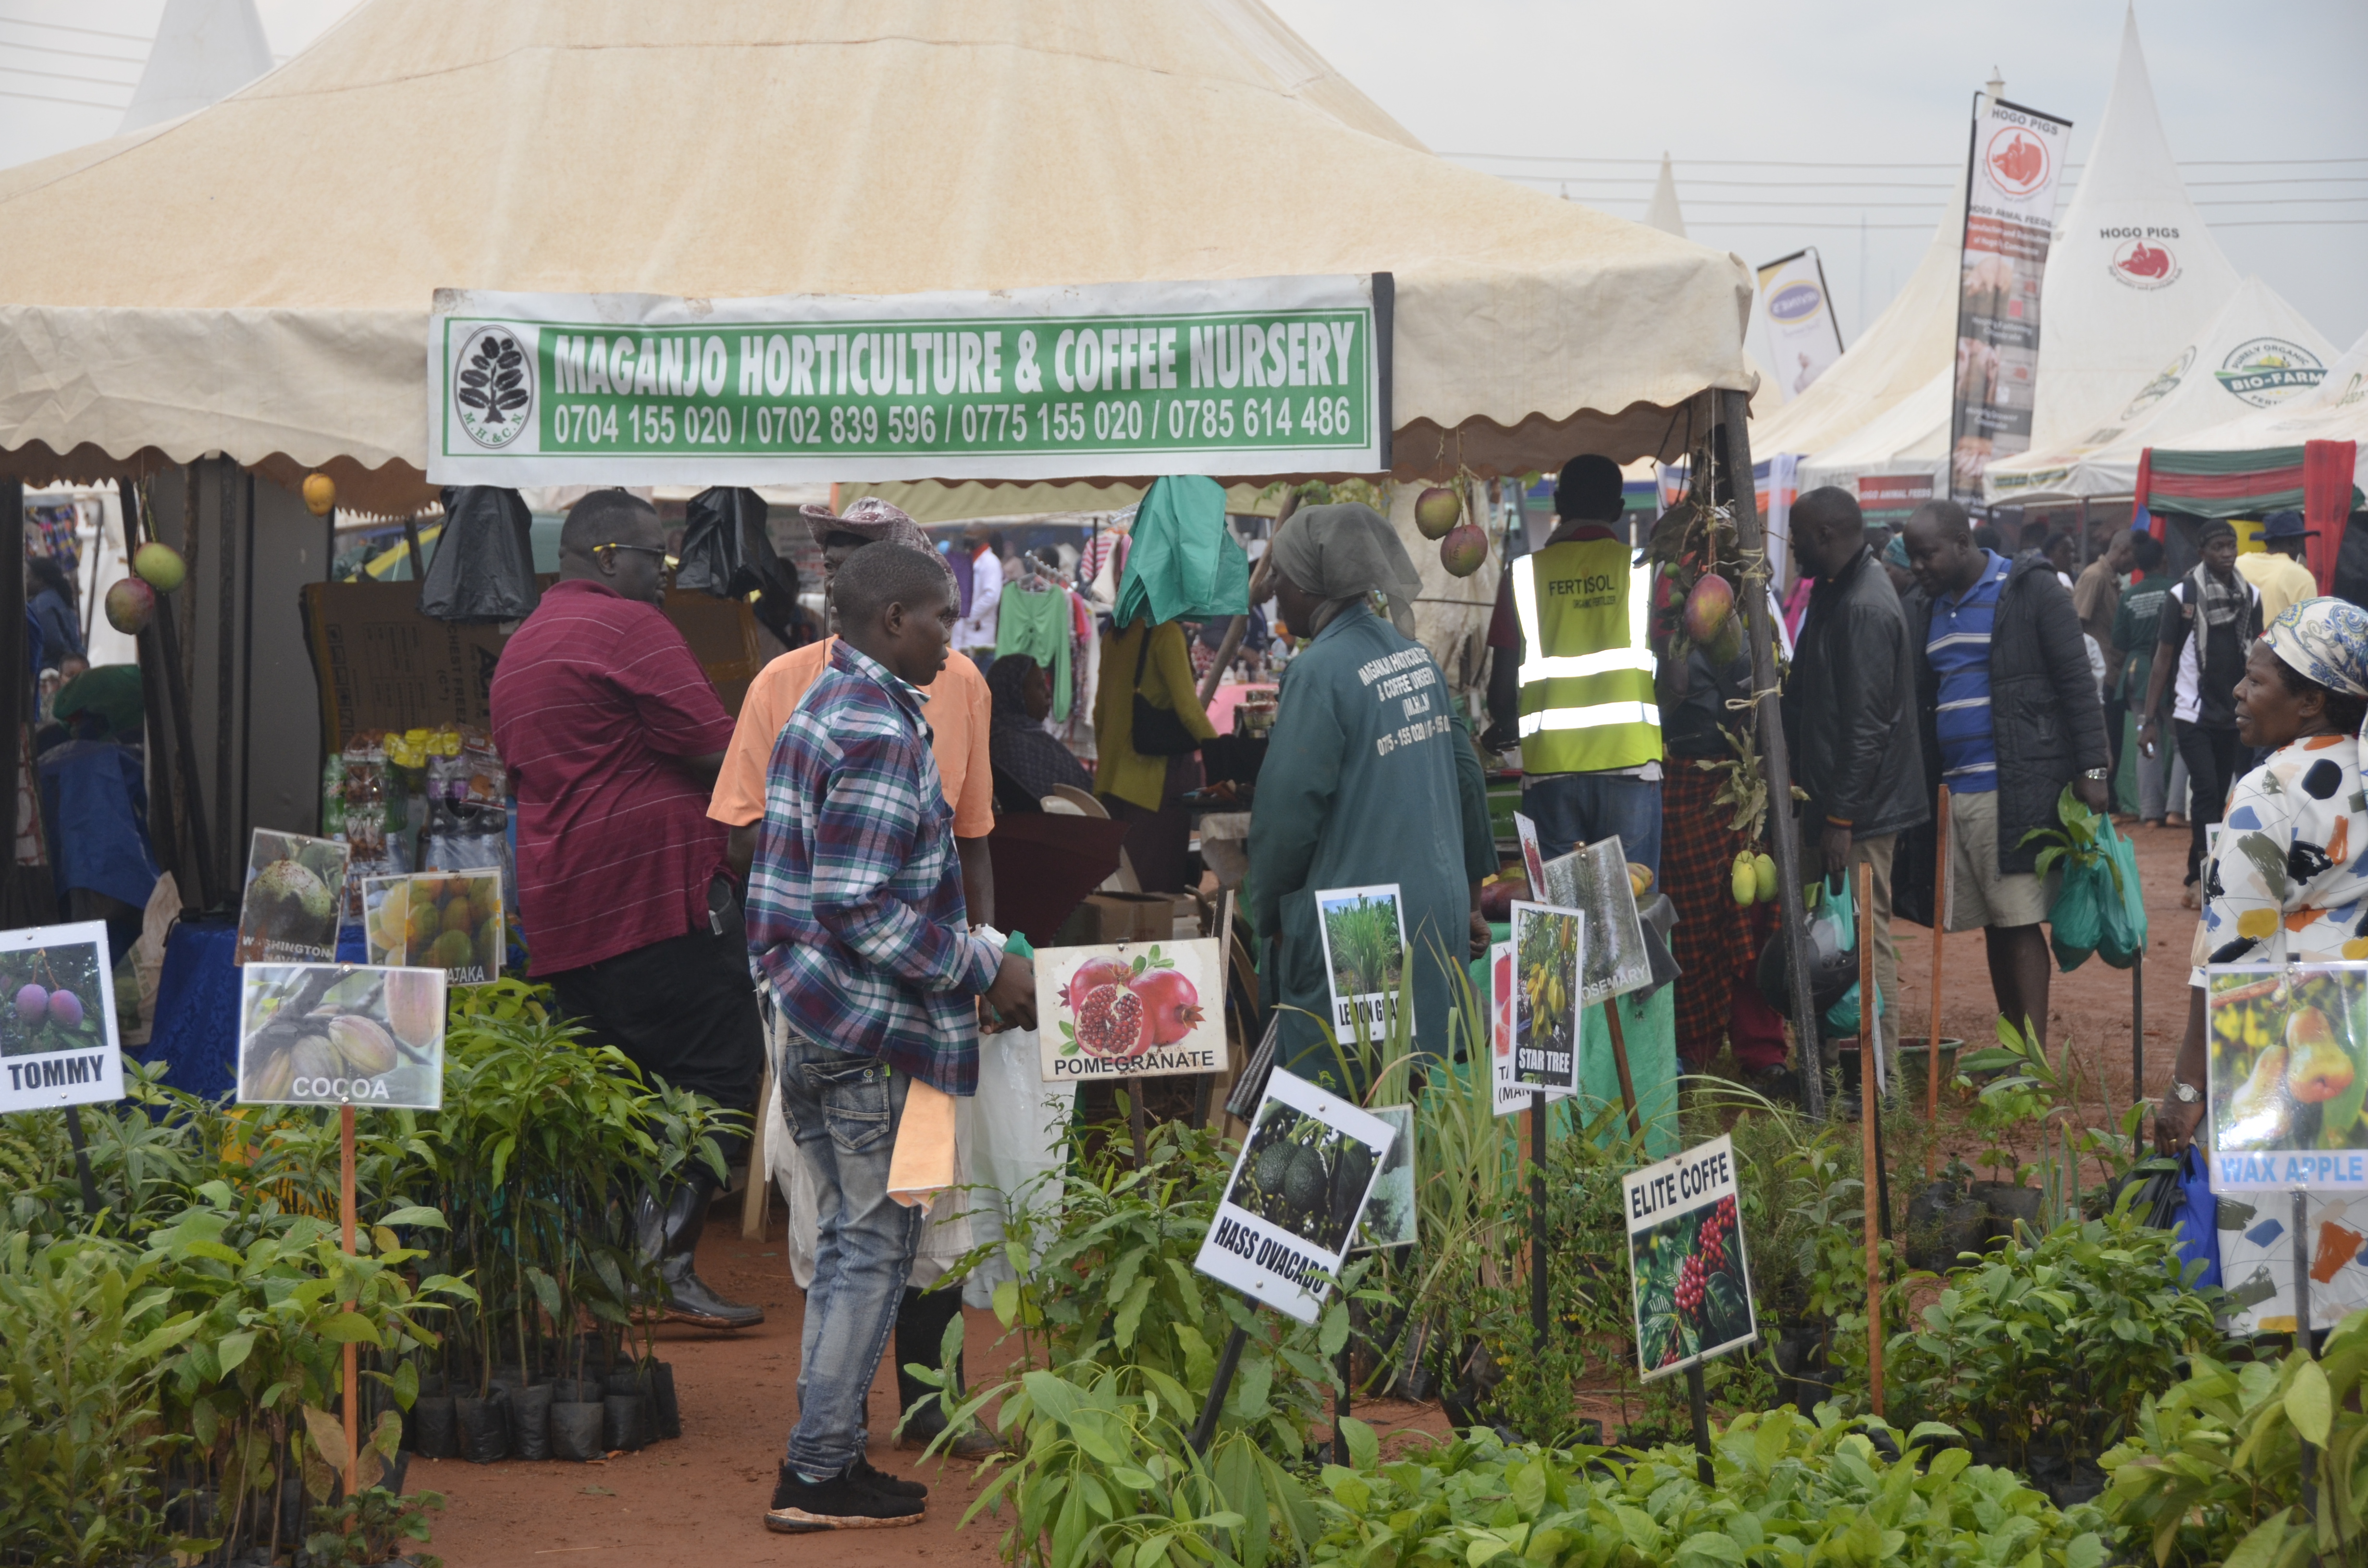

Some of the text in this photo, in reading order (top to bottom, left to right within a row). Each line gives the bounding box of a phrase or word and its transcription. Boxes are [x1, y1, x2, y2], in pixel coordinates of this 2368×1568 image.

[1991, 108, 2059, 135] HOGO PIGS
[2100, 227, 2180, 239] HOGO PIGS
[554, 321, 1355, 397] MAGANJO HORTICULTURE & COFFEE NURSERY
[2231, 344, 2310, 369] PURELY ORGANIC
[2231, 371, 2324, 391] BIO-FARM
[555, 395, 1350, 443] 0704 155 020 / 0702 839 596 / 0775 155 020 / 0785 614 486
[1549, 575, 1615, 596] FERTISOL
[447, 625, 467, 724] CHEST FREEZ
[1377, 684, 1385, 702] &
[1382, 674, 1413, 699] COFFEE
[1397, 726, 1412, 746] 155
[1410, 723, 1425, 742] 020
[243, 935, 331, 958] WSHINGTON
[1581, 965, 1645, 1001] OSEMARY
[7, 1054, 104, 1091] TOMMY
[1054, 1050, 1215, 1075] POMEGRANATE
[1518, 1047, 1570, 1073] STAR TREE
[292, 1076, 390, 1100] COCOA
[2220, 1156, 2363, 1183] WAX APPLE
[1631, 1151, 1729, 1220] ELITE COFFE
[1213, 1216, 1329, 1294] HASS OVACADO
